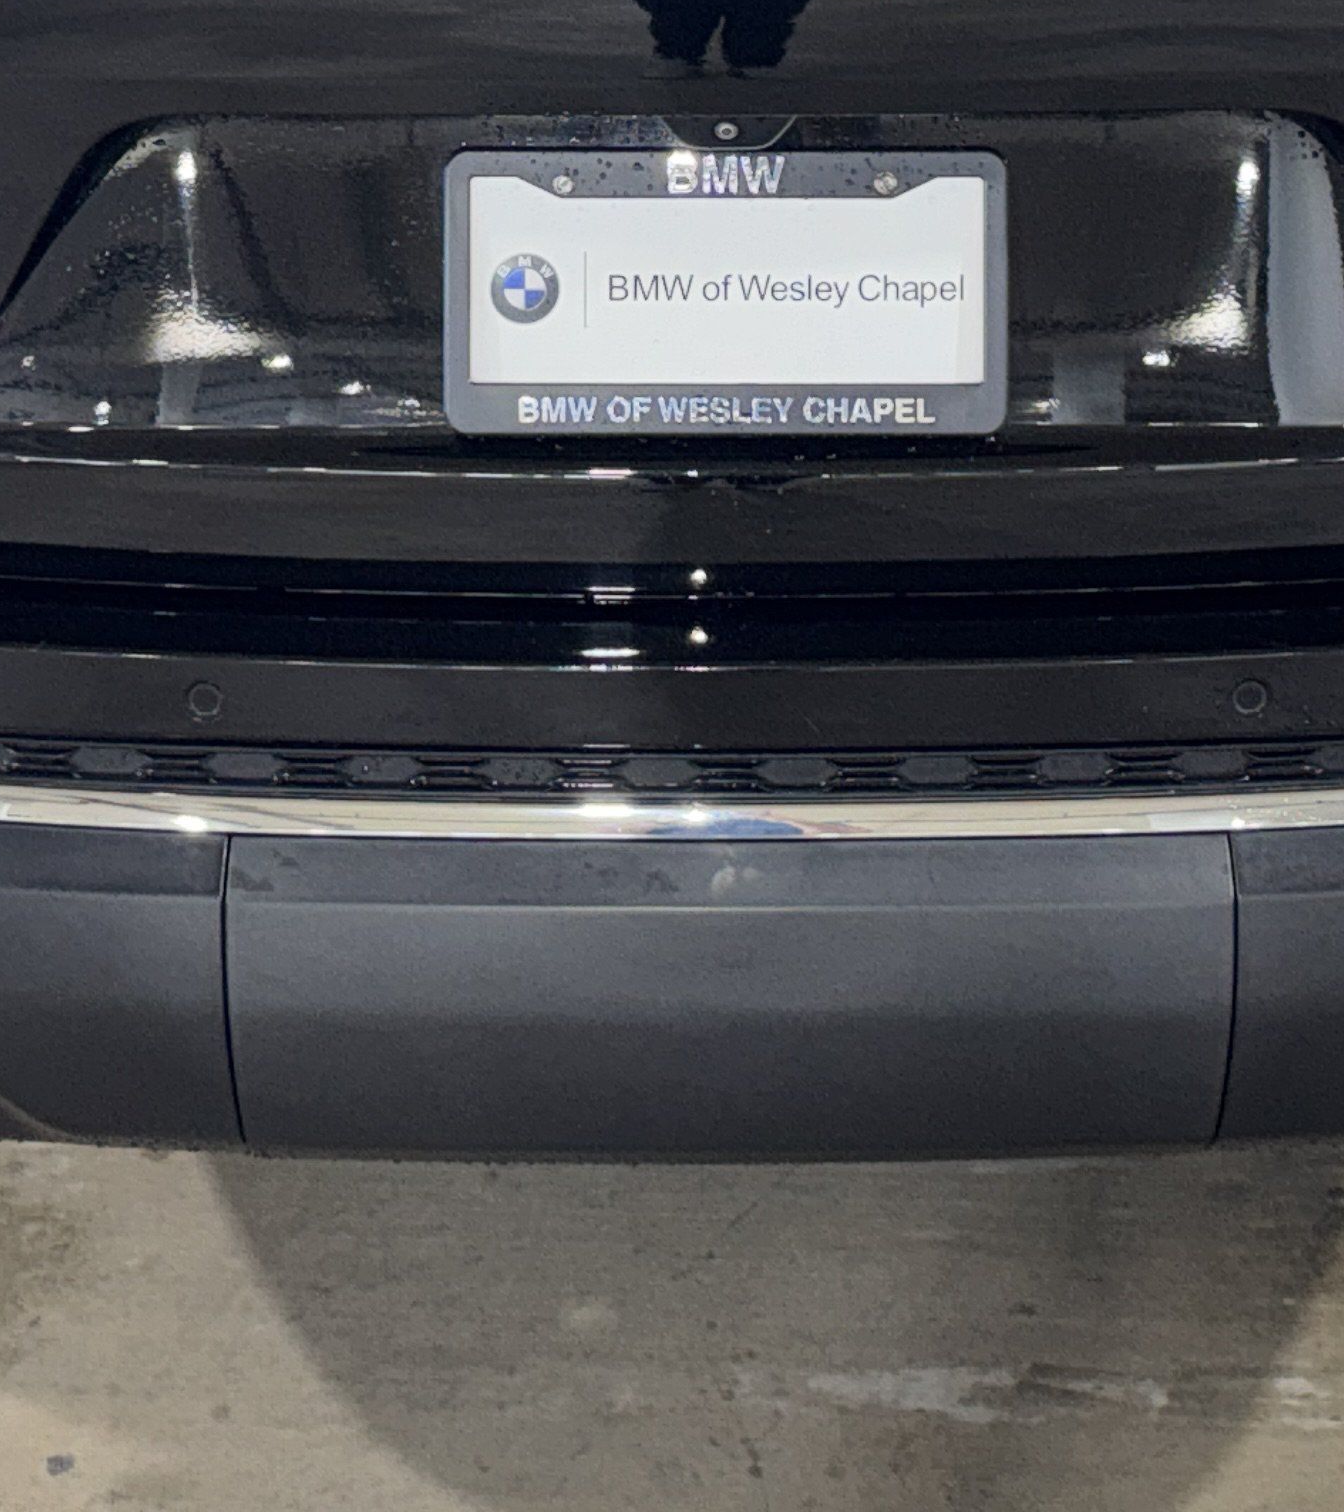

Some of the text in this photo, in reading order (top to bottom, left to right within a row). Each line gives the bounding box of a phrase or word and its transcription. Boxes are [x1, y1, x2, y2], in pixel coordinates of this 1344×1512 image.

[666, 150, 785, 194] BMW
[607, 274, 966, 309] BMW of Wesley Chapel
[517, 395, 936, 425] BMW OF WESLEY CHAPEL
